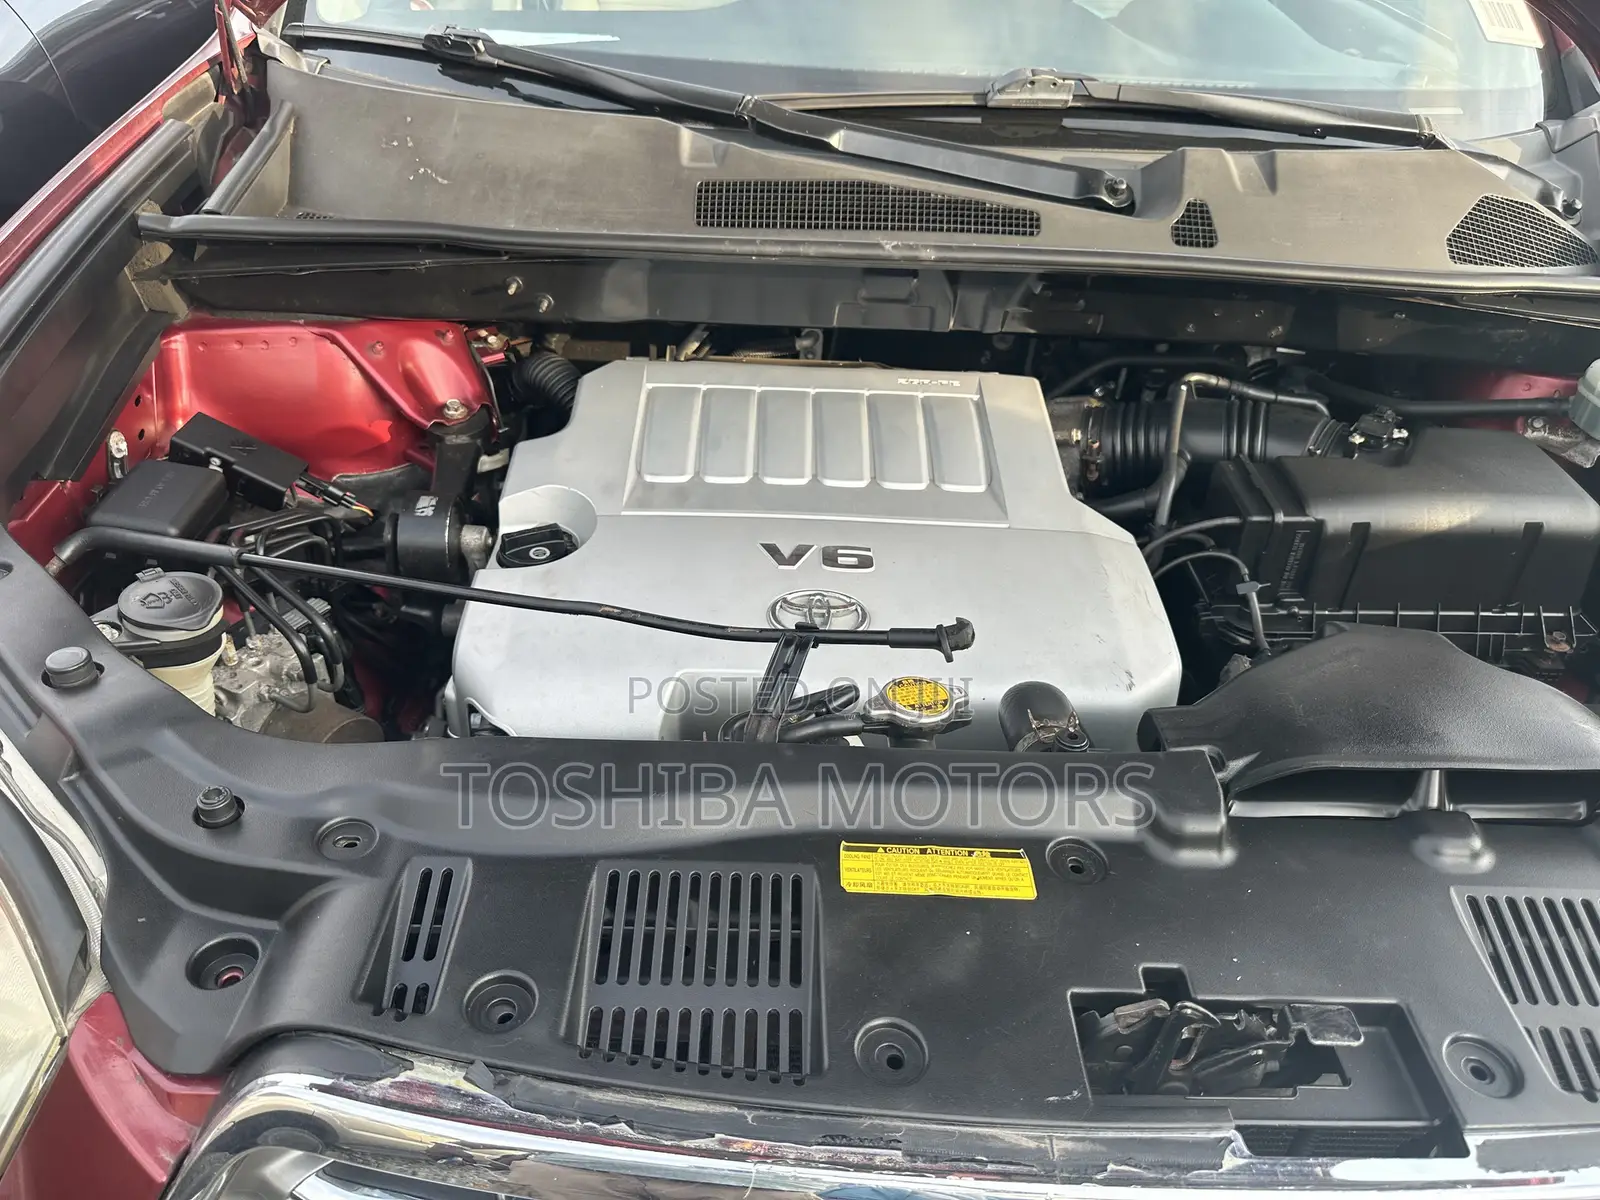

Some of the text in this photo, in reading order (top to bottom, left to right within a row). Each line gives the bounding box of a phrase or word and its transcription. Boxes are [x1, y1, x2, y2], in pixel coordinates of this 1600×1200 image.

[757, 542, 876, 573] V6
[886, 847, 920, 855] CAUTION
[926, 848, 969, 857] ATTENTION
